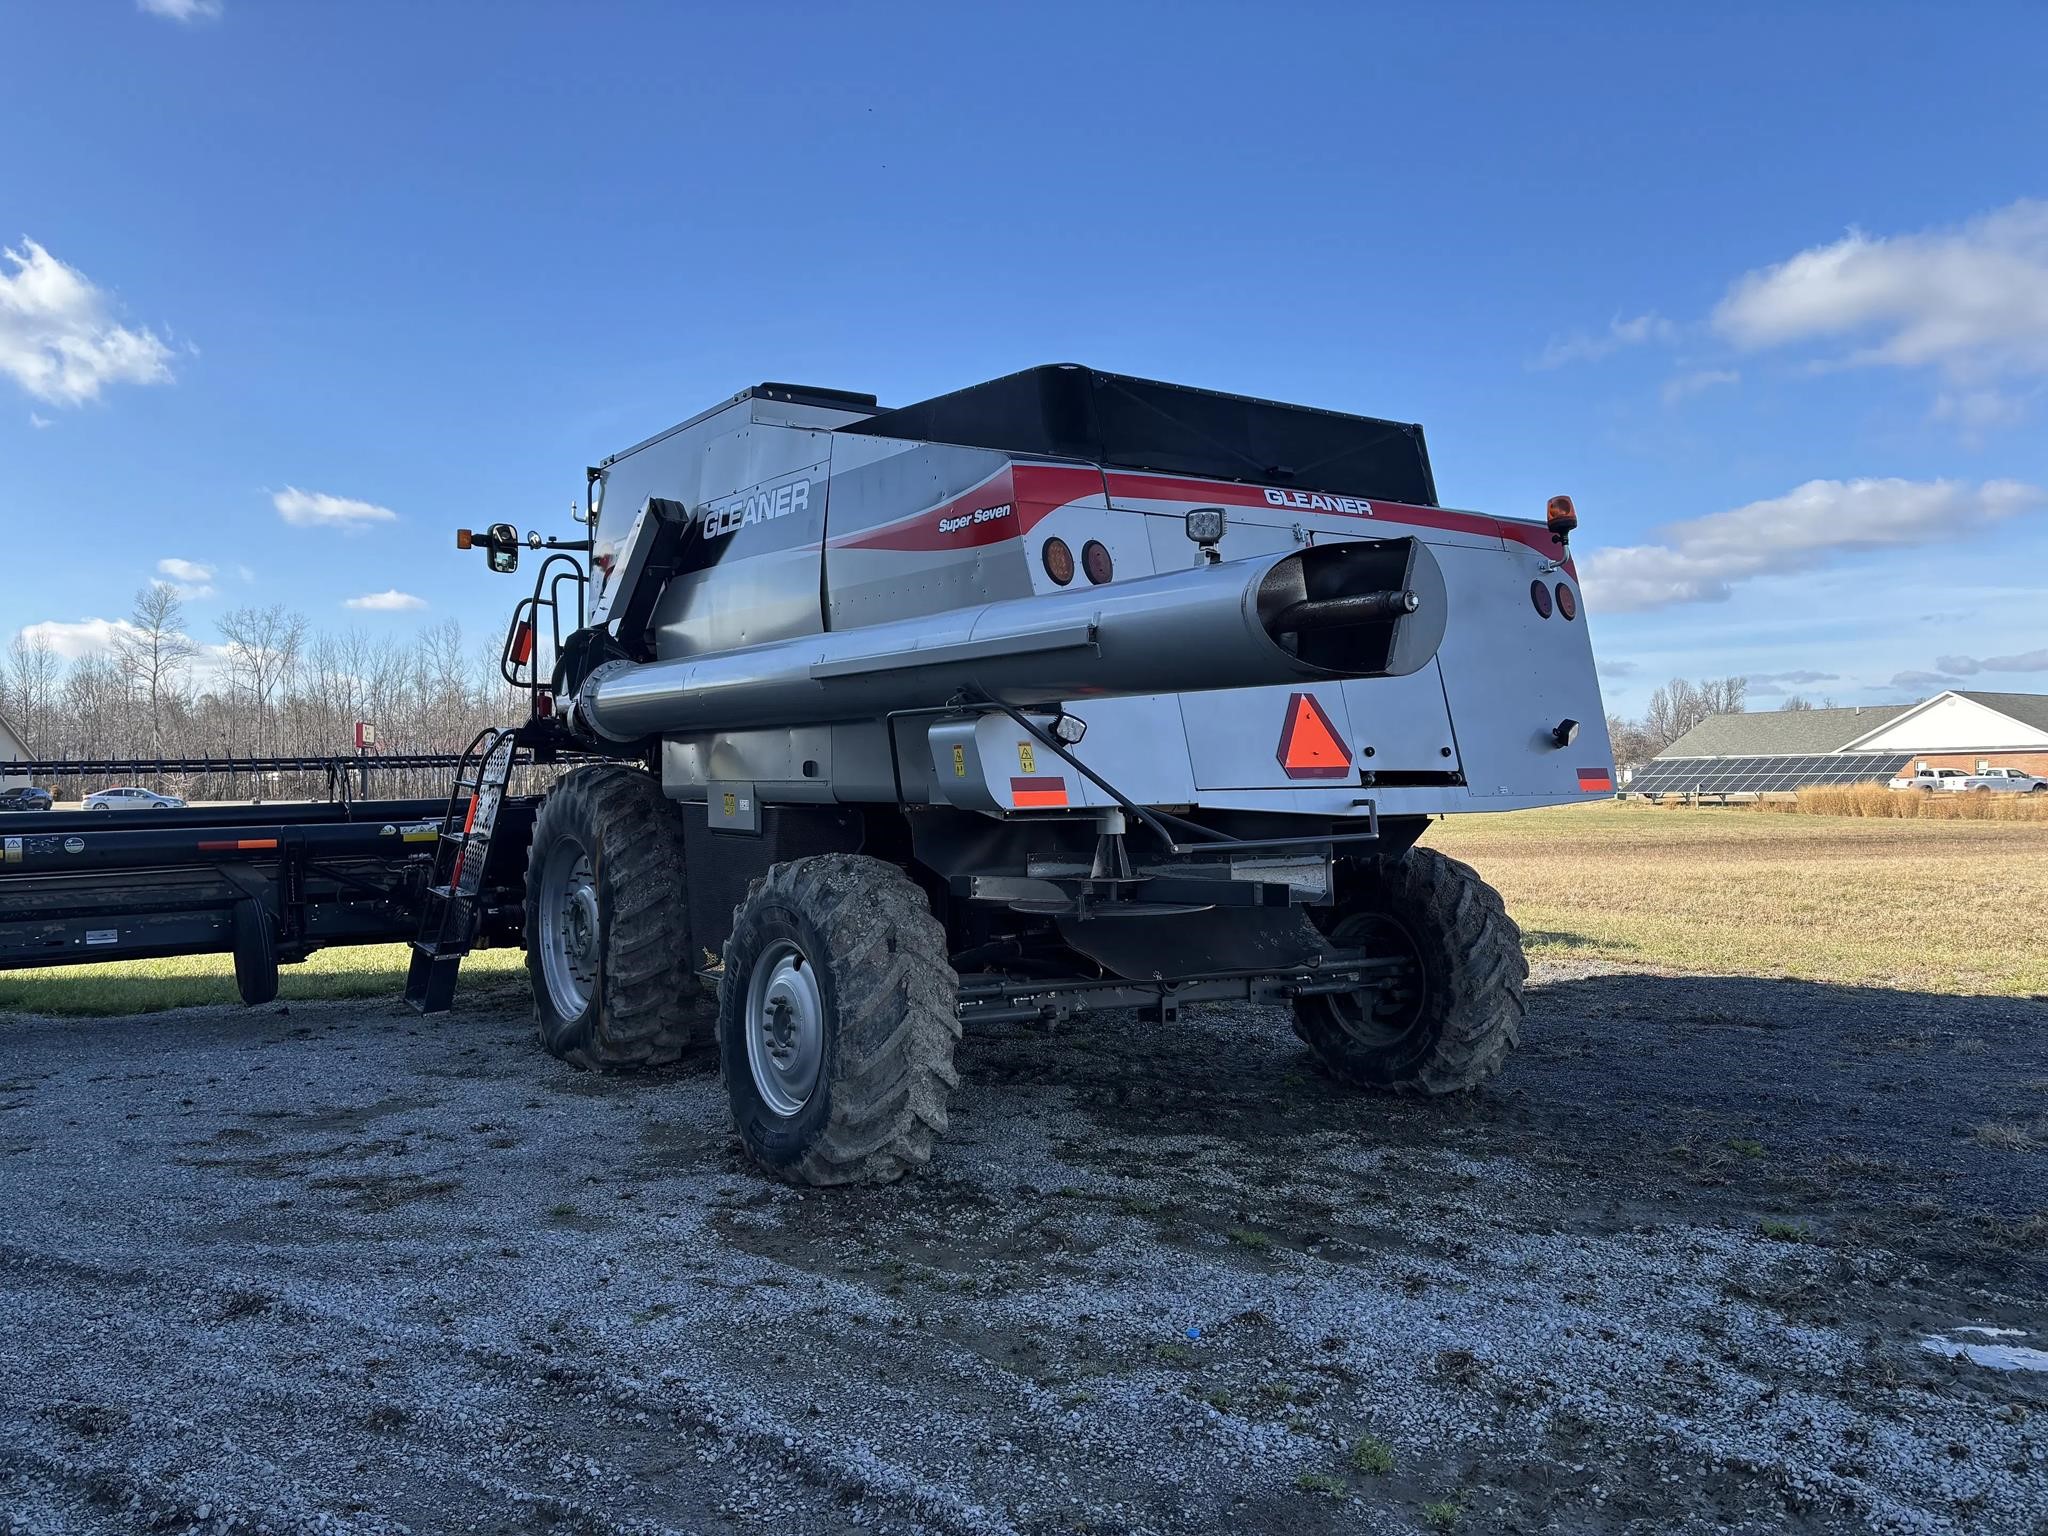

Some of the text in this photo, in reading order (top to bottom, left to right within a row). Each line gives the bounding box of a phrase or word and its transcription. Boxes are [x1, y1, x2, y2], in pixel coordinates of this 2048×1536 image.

[703, 479, 810, 540] GLEANER
[1263, 489, 1373, 516] GLEANER
[939, 504, 1011, 532] Super Seven
